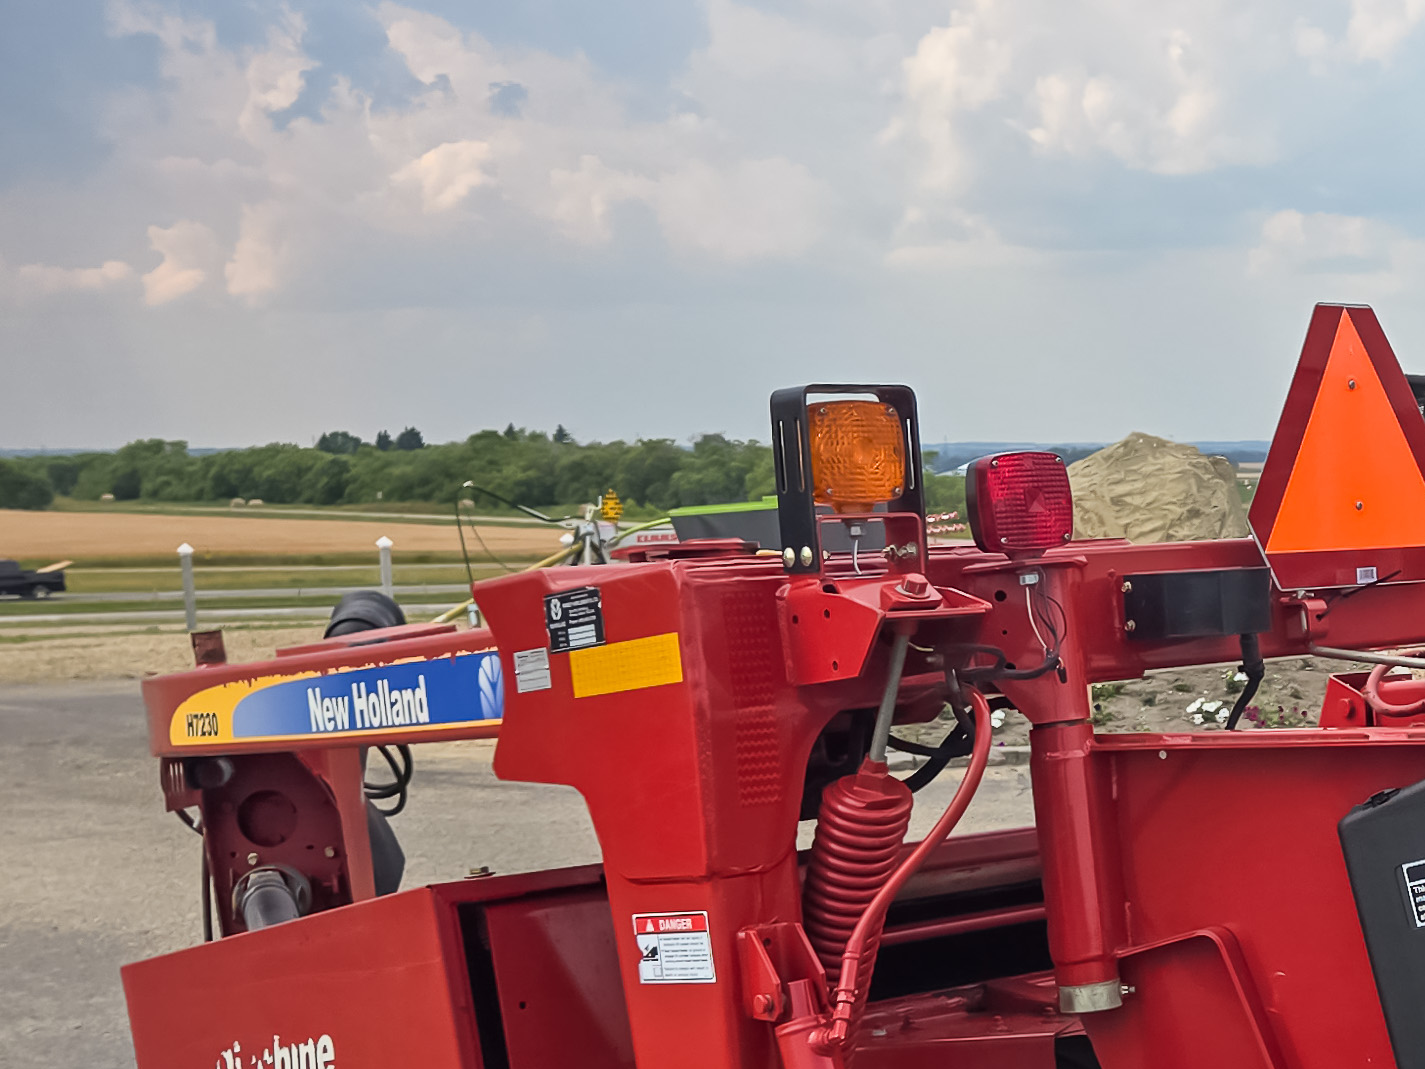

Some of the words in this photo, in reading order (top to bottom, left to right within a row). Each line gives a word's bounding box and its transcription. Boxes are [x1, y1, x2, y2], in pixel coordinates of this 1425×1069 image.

[307, 686, 350, 733] New
[351, 674, 430, 730] Holland
[185, 712, 219, 738] H7230
[658, 918, 693, 931] DANGER
